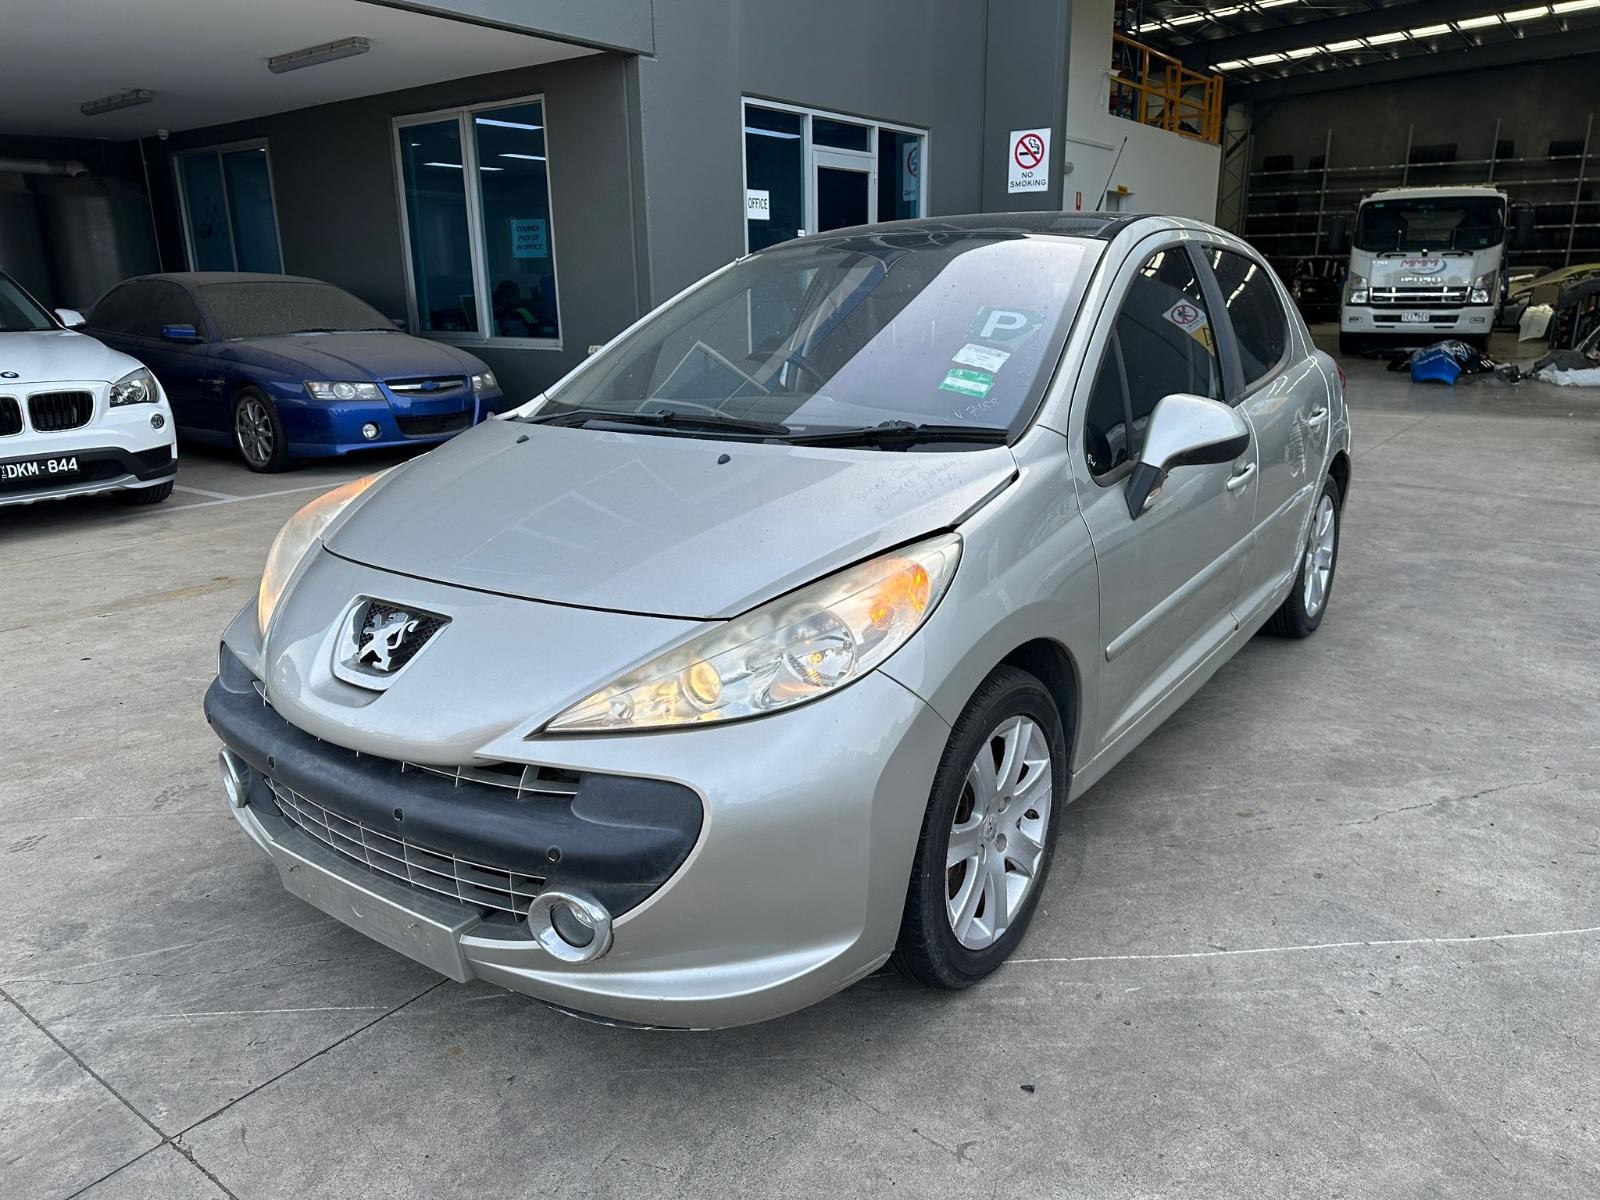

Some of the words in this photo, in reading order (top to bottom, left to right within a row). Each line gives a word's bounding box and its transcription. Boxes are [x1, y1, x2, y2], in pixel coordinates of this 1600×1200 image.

[1021, 171, 1034, 179] NO
[1009, 179, 1047, 188] SMOKING
[747, 197, 768, 210] OFFICE
[980, 310, 1028, 338] P
